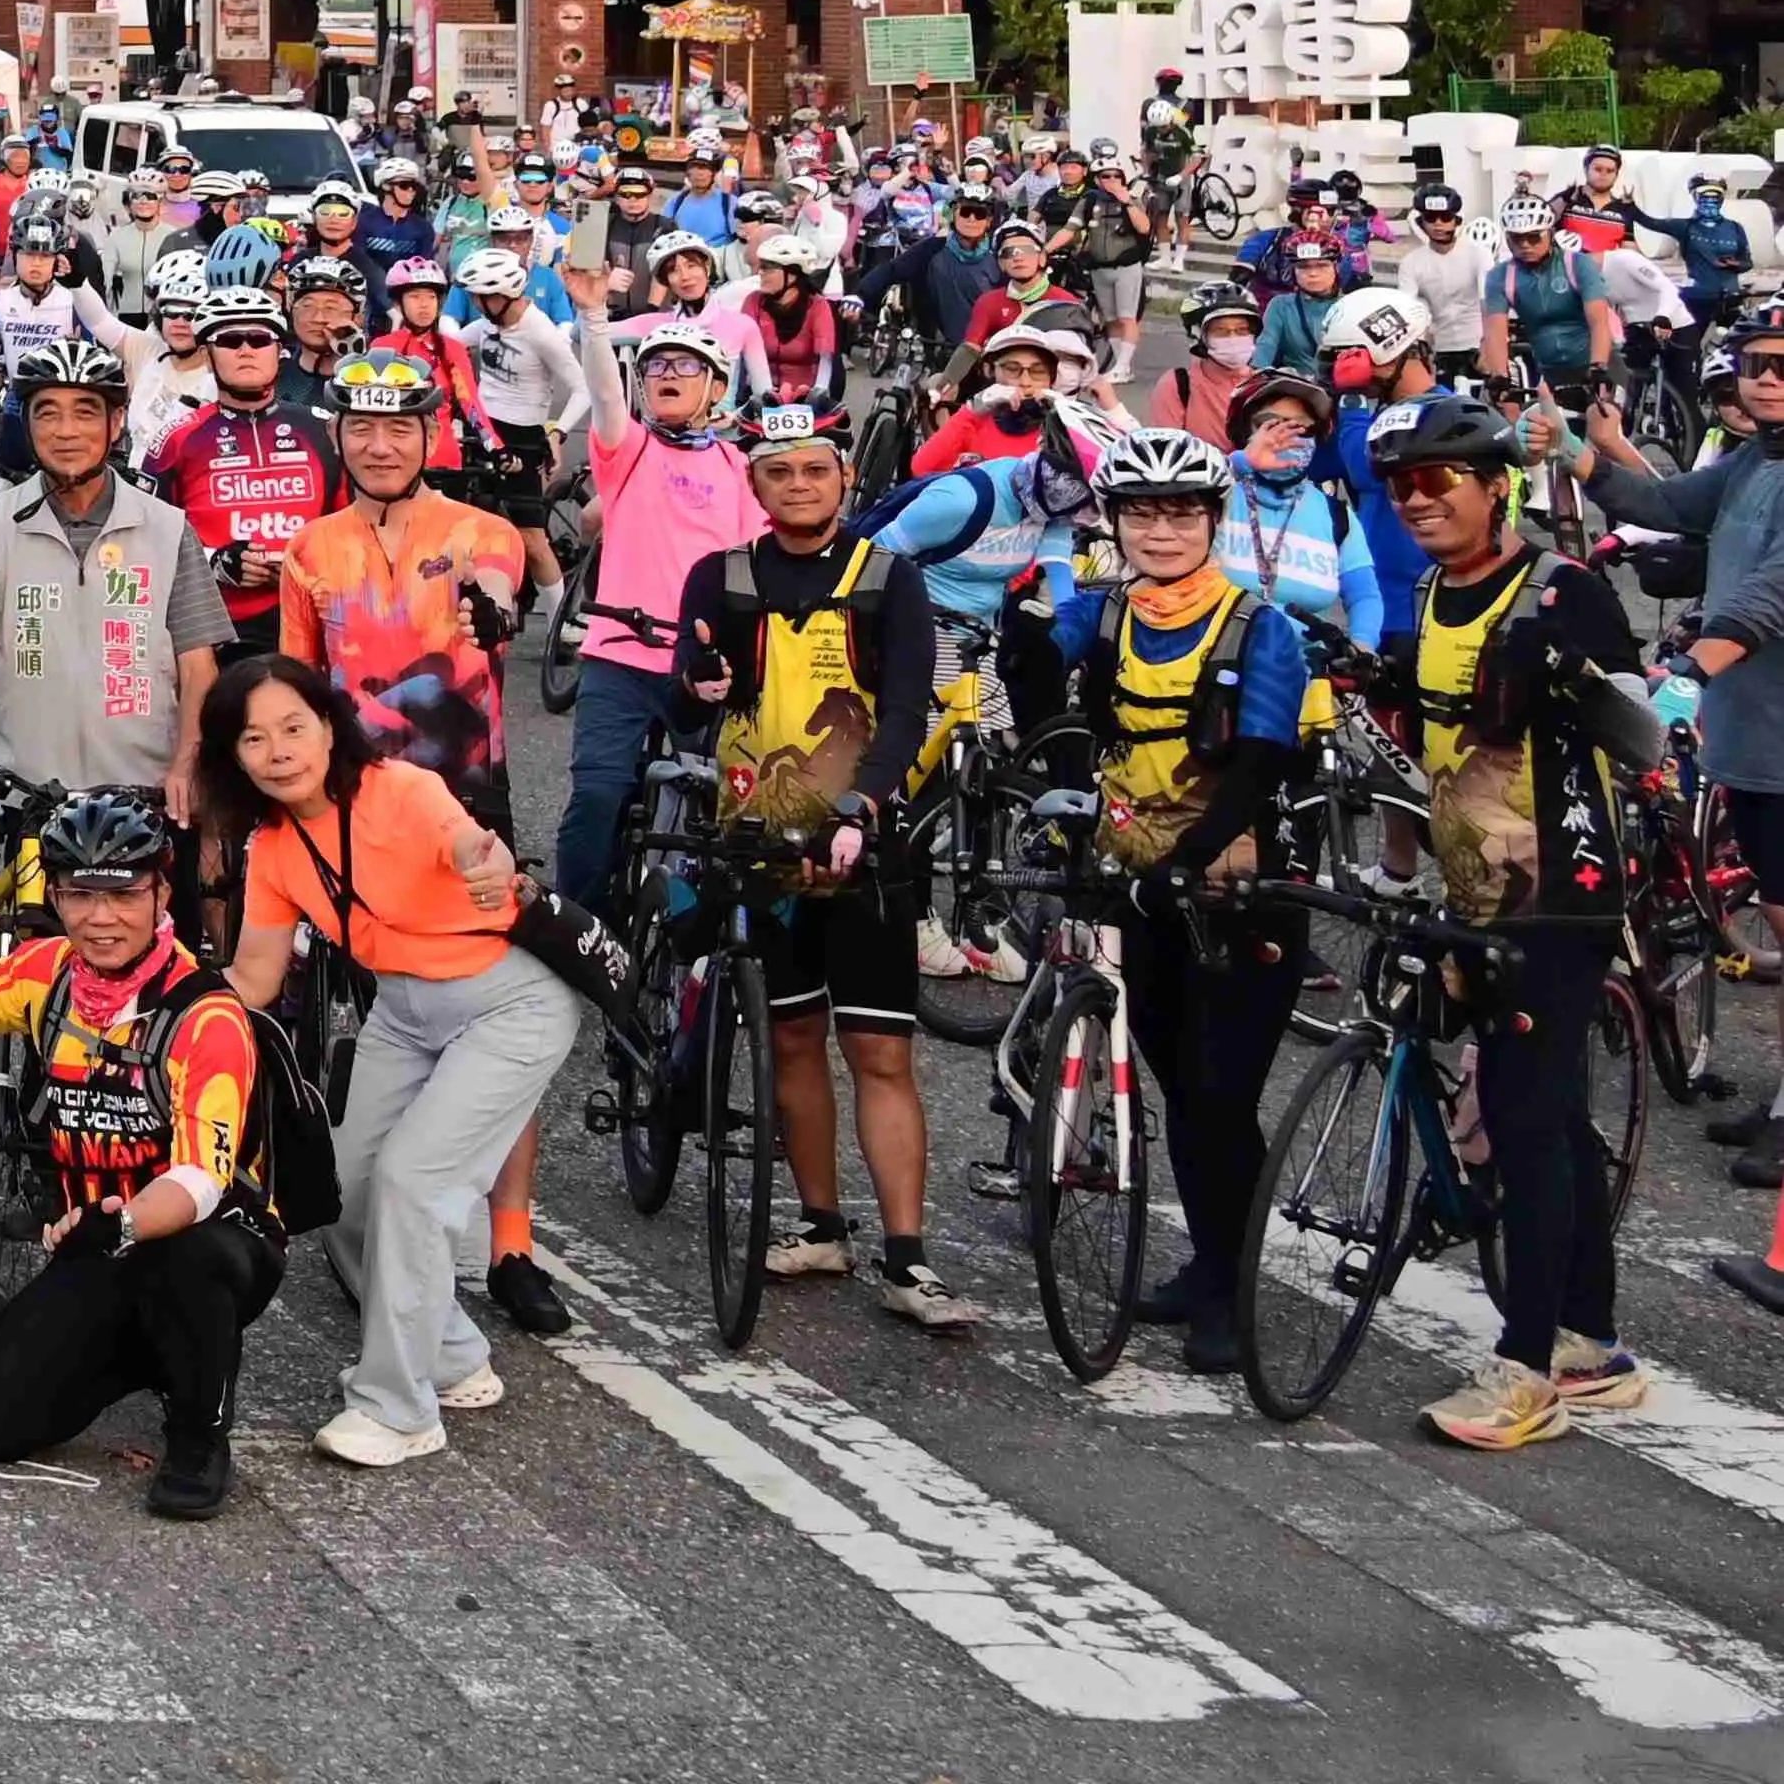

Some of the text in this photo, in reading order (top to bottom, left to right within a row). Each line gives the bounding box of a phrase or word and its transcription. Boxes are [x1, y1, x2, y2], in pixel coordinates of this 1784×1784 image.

[355, 389, 396, 407] 1142
[767, 414, 810, 431] 863
[216, 473, 306, 500] Silence
[229, 511, 305, 541] Lotto
[16, 585, 43, 677] 邱清順
